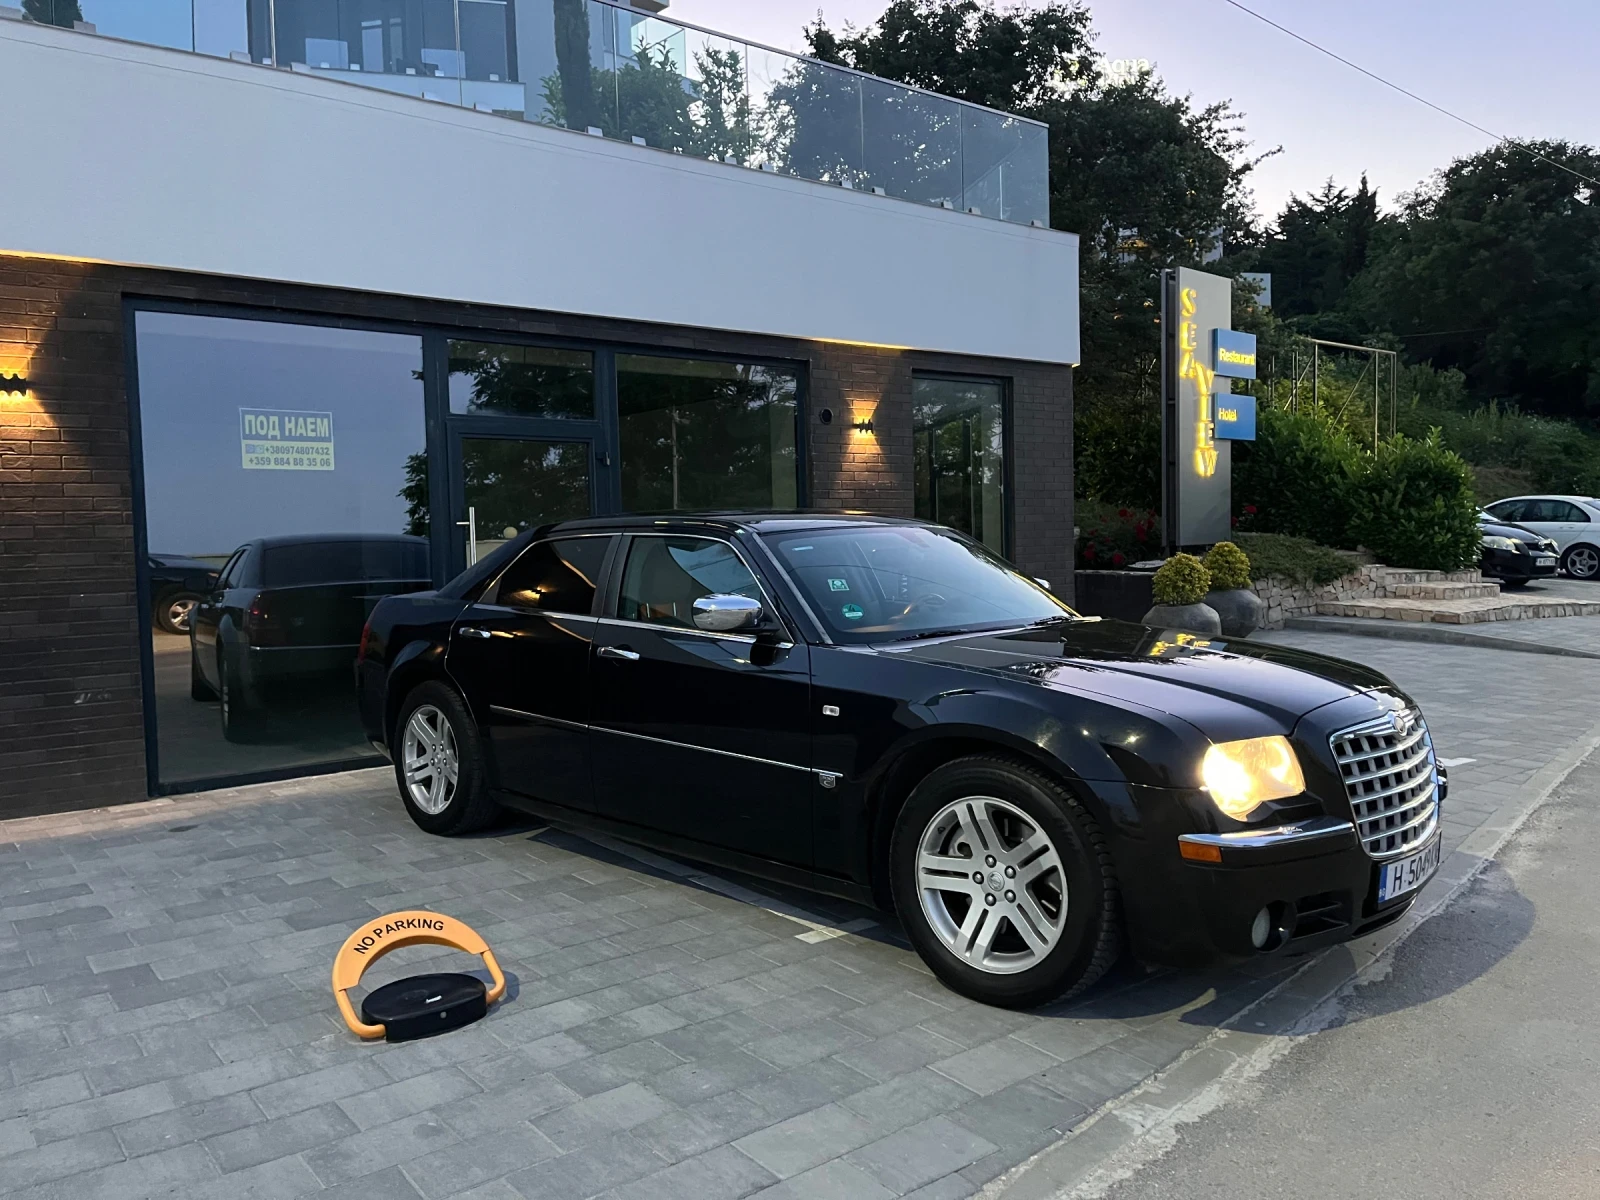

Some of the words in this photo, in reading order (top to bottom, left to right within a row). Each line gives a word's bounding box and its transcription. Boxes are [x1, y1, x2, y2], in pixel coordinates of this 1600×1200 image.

[1219, 347, 1256, 366] Restaurant
[1218, 407, 1238, 422] Hotel
[244, 414, 281, 440] ПОД
[284, 416, 330, 438] НАЕМ
[265, 445, 331, 456] +380974807432
[249, 456, 271, 466] +359
[306, 457, 318, 467] 35
[320, 458, 331, 467] 06
[1392, 863, 1404, 893] H
[353, 935, 375, 955] NO
[372, 918, 445, 939] PARKING
